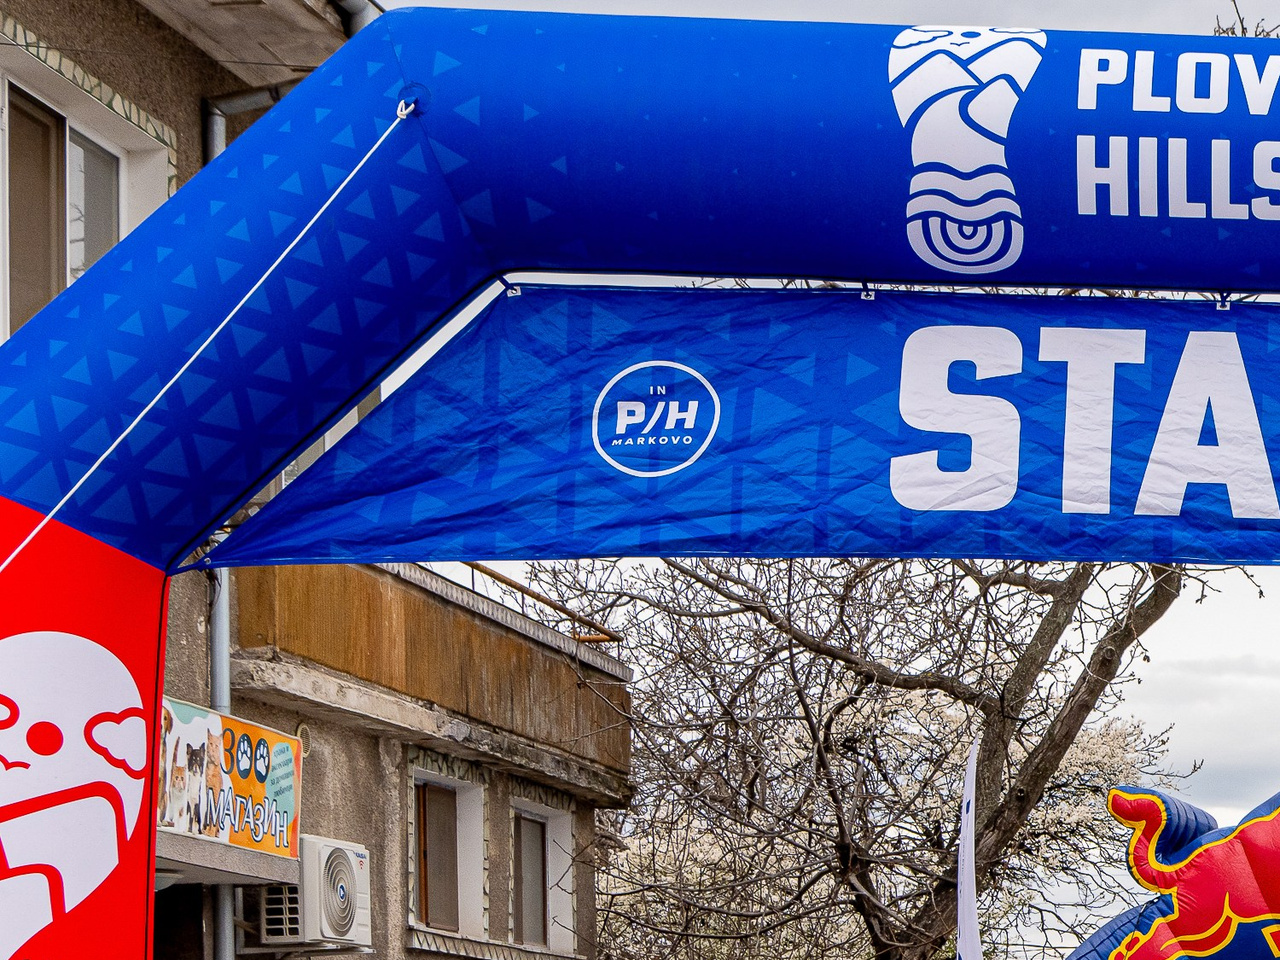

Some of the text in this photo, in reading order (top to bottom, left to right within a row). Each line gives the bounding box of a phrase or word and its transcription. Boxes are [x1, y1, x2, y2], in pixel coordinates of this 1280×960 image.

[649, 385, 666, 395] IN
[615, 400, 699, 435] P/H
[611, 435, 693, 446] MARKOVO
[206, 786, 289, 848] МАГАЗИН
